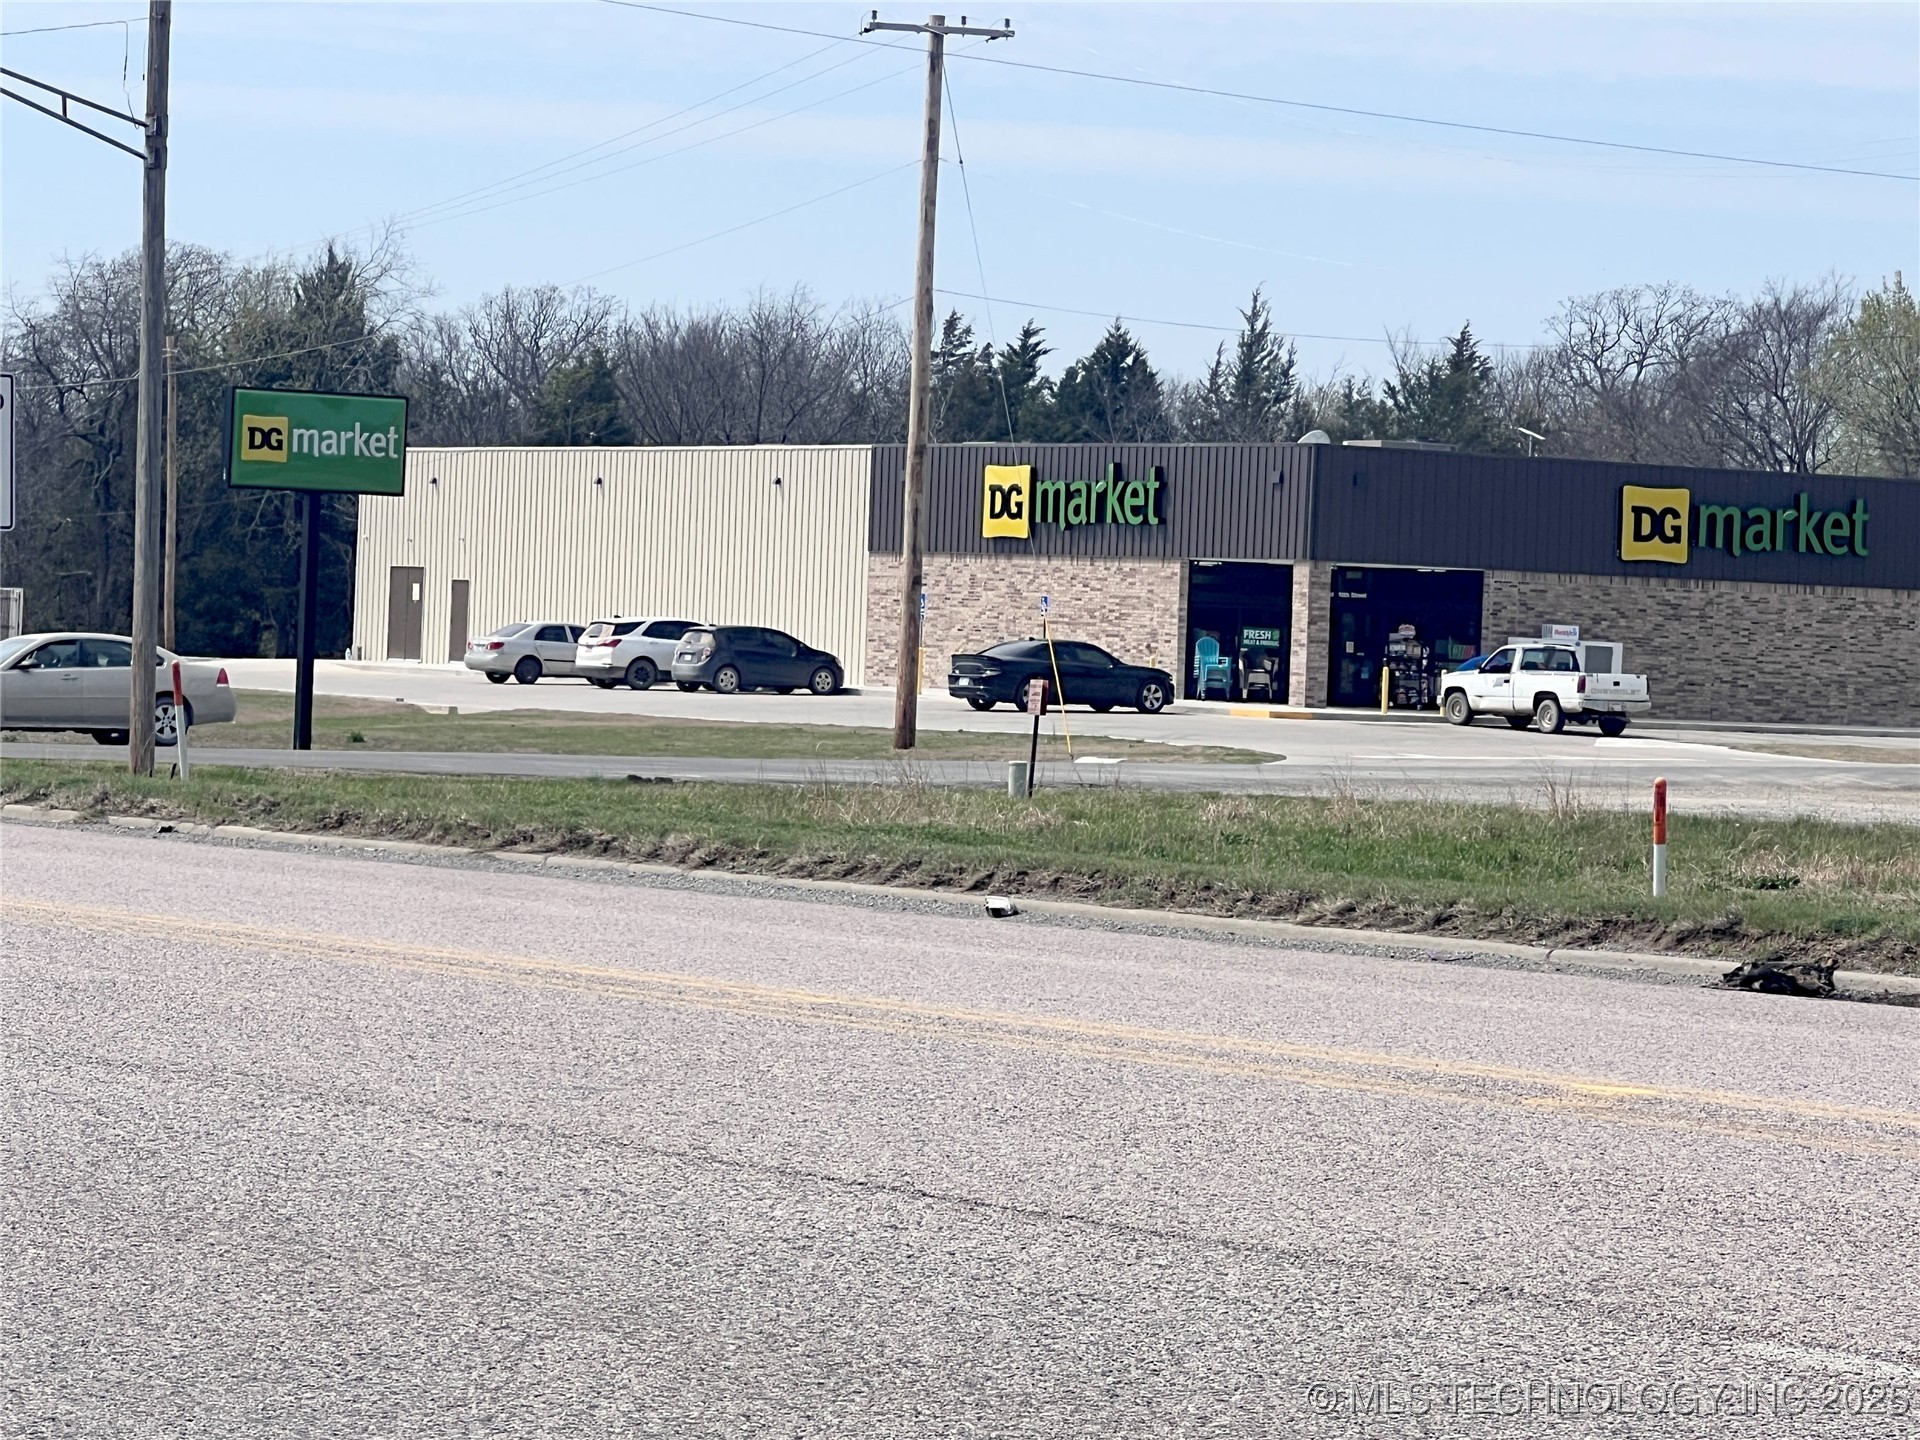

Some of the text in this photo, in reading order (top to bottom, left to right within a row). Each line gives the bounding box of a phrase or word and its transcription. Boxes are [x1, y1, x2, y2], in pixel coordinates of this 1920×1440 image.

[248, 421, 399, 458] DG market
[988, 462, 1161, 531] DG market
[1631, 492, 1870, 557] DG market
[1243, 629, 1272, 640] FRESH
